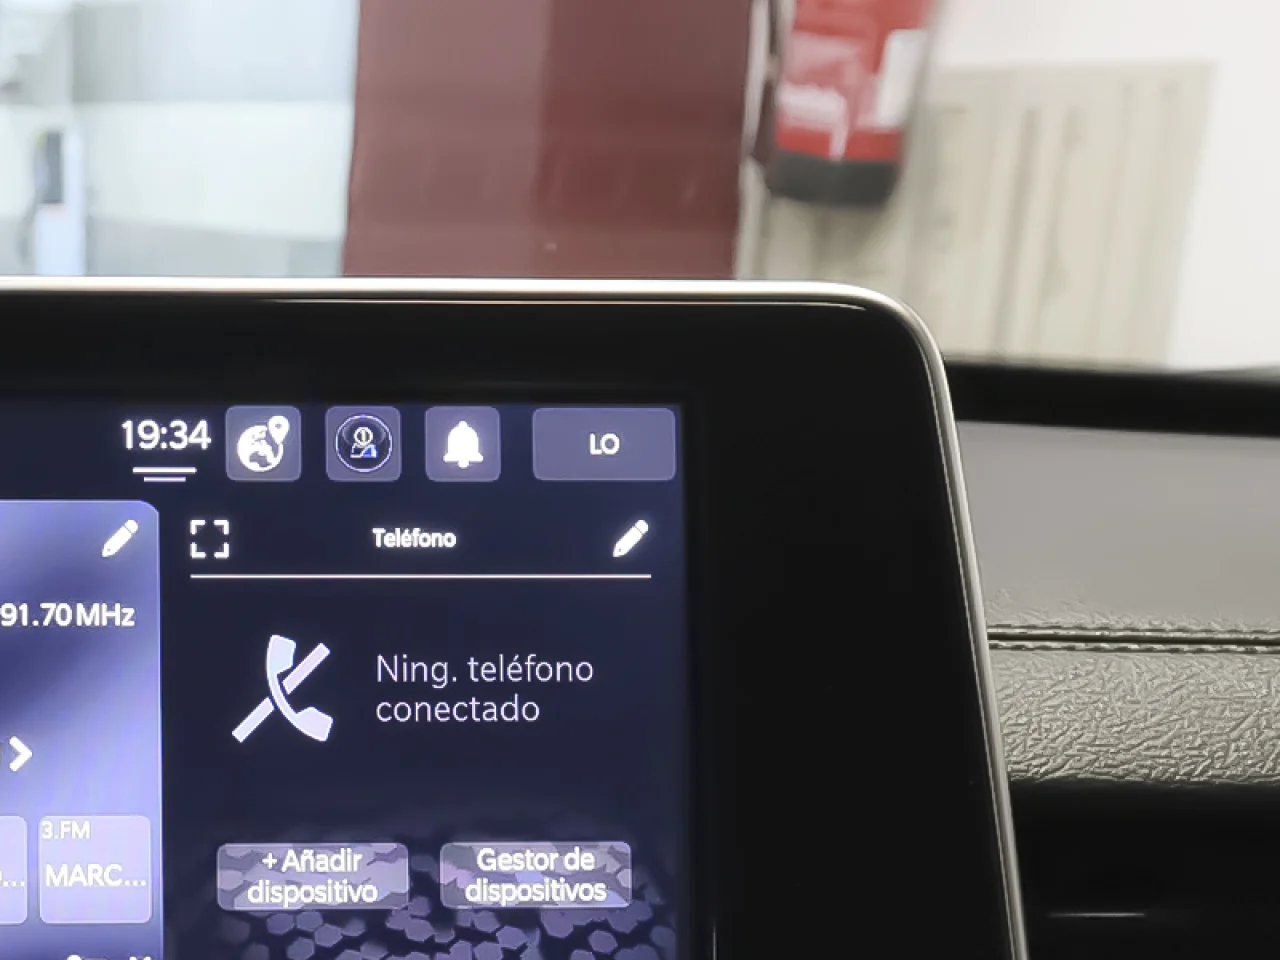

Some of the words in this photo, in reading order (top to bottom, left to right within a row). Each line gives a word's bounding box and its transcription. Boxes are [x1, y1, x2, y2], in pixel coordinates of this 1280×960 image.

[121, 419, 211, 451] 19:34
[589, 433, 620, 455] LO
[372, 528, 457, 548] Teléfono
[377, 654, 457, 688] Ning.
[467, 654, 593, 682] teléfono
[377, 694, 540, 722] conectado
[40, 820, 91, 839] 3.FM
[282, 848, 362, 872] Añadir
[476, 848, 558, 872] Gestor
[563, 848, 595, 871] de
[247, 880, 379, 907] dispositivo
[465, 878, 607, 904] dispositivos
